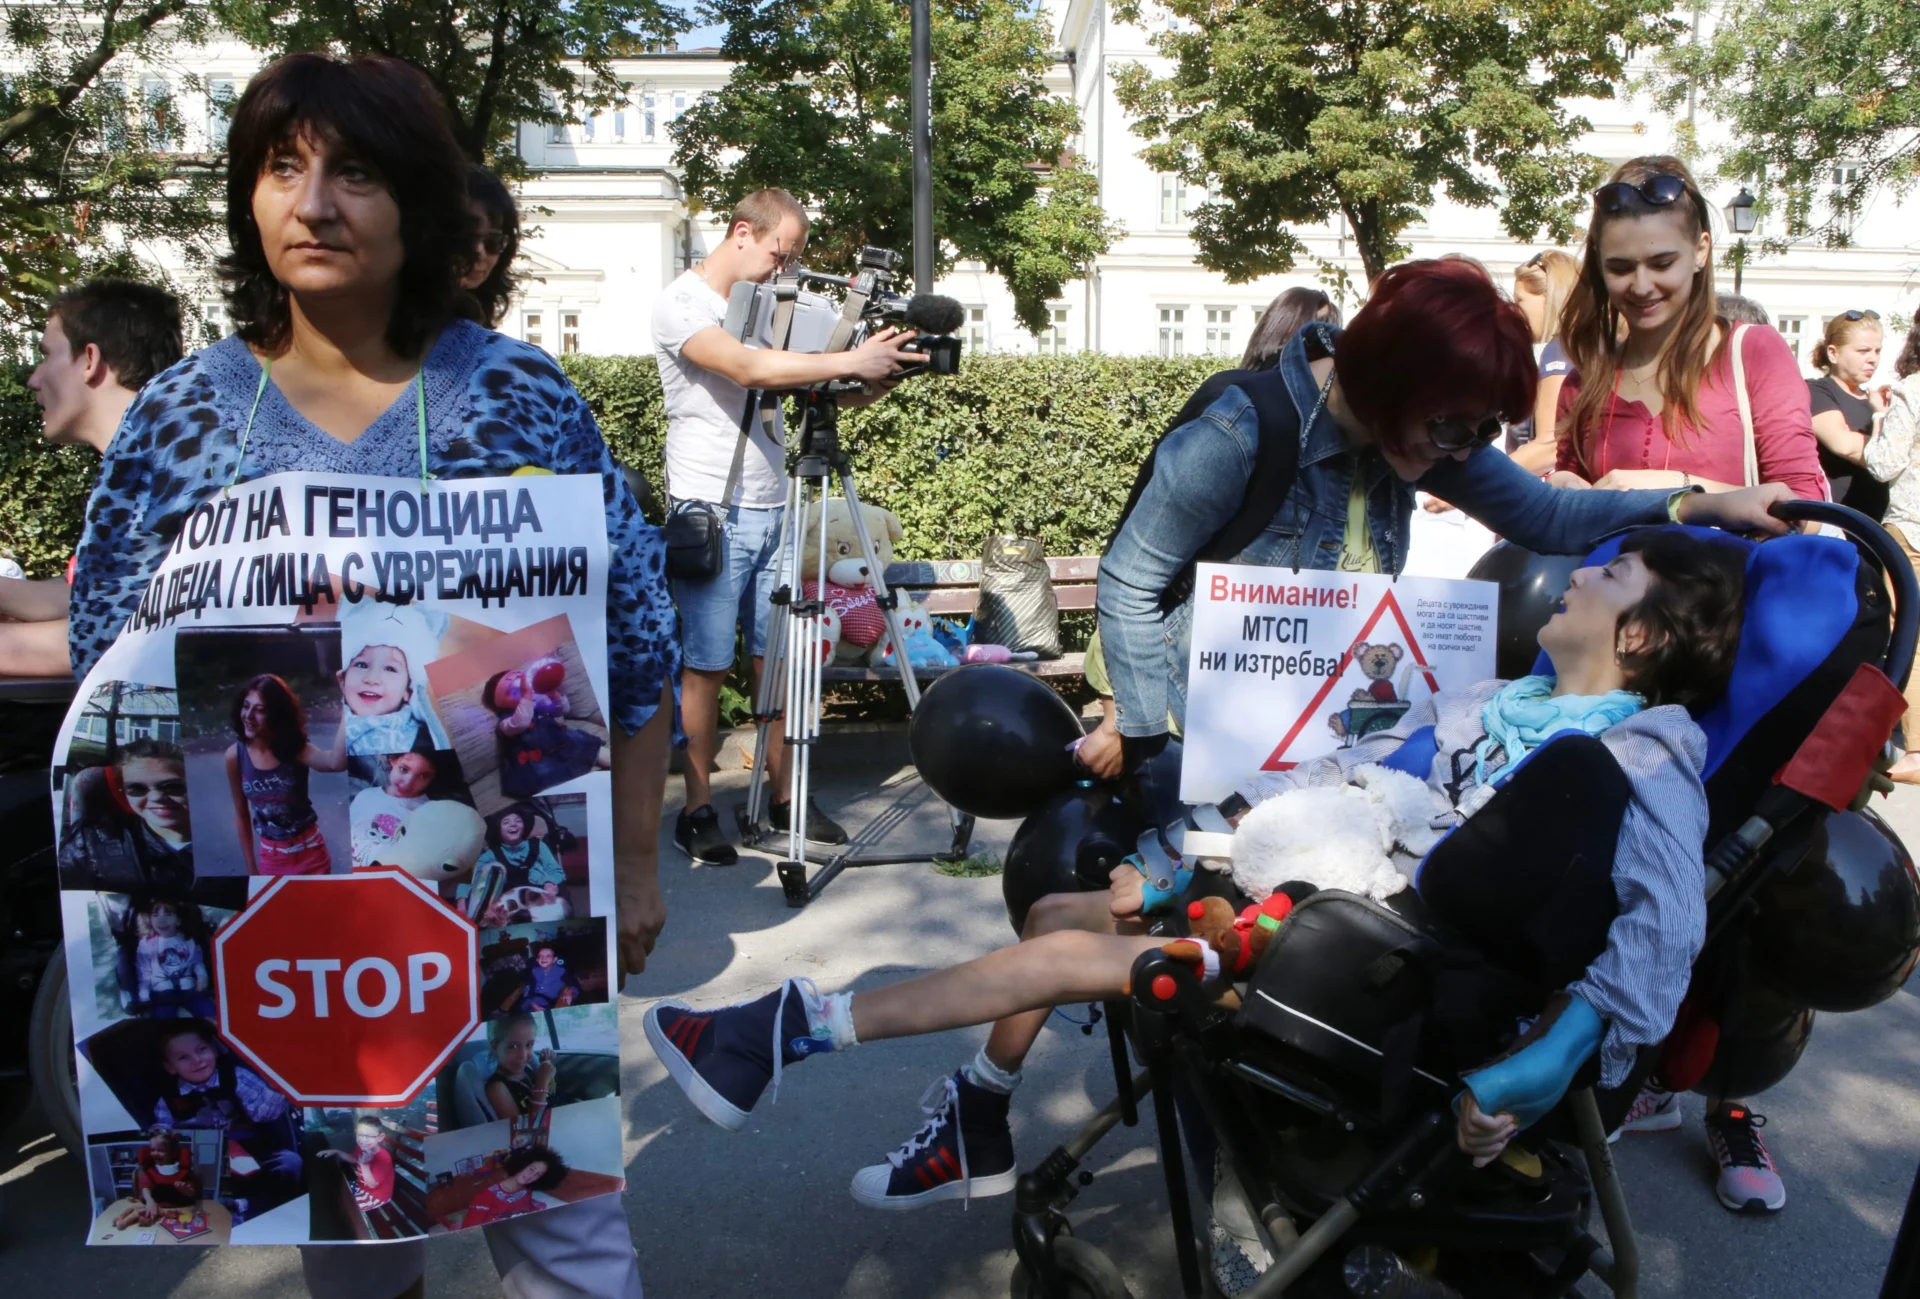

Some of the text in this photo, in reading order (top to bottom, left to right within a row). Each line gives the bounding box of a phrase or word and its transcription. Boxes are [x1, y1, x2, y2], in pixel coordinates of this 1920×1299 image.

[243, 486, 291, 543] НА
[304, 485, 543, 545] ГЕНОЦИДА
[161, 558, 222, 619] ДЕЦА
[227, 556, 244, 608] /
[243, 552, 336, 615] ЛИЦА
[341, 551, 364, 604] С
[371, 546, 588, 609] УВРЕЖДАНИЯ
[1210, 574, 1358, 609] Внимание!
[1417, 598, 1442, 608] Децата
[1449, 602, 1489, 611] увреждания
[1456, 613, 1489, 621] щастливи
[1242, 615, 1308, 644] МТСП
[1199, 650, 1345, 681] ни изтребва!
[254, 951, 452, 1019] STOP
